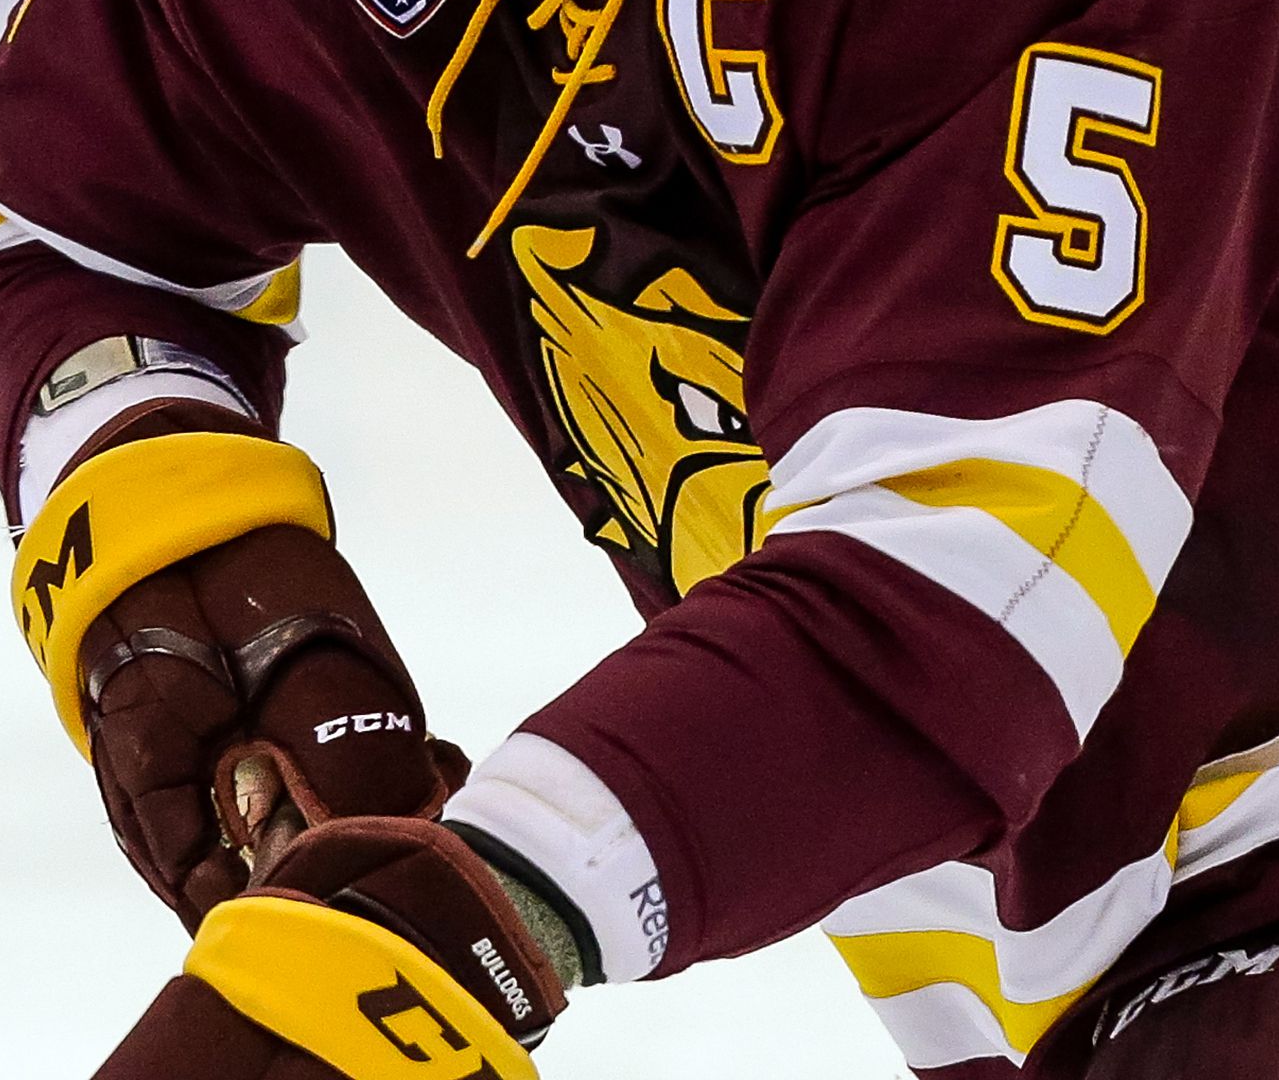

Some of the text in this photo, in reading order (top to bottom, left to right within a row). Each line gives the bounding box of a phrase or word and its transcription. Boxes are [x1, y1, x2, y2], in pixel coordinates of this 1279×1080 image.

[991, 42, 1163, 336] 5
[314, 712, 412, 744] CCM
[629, 875, 669, 966] Ree
[471, 936, 533, 1022] BULLDOGS
